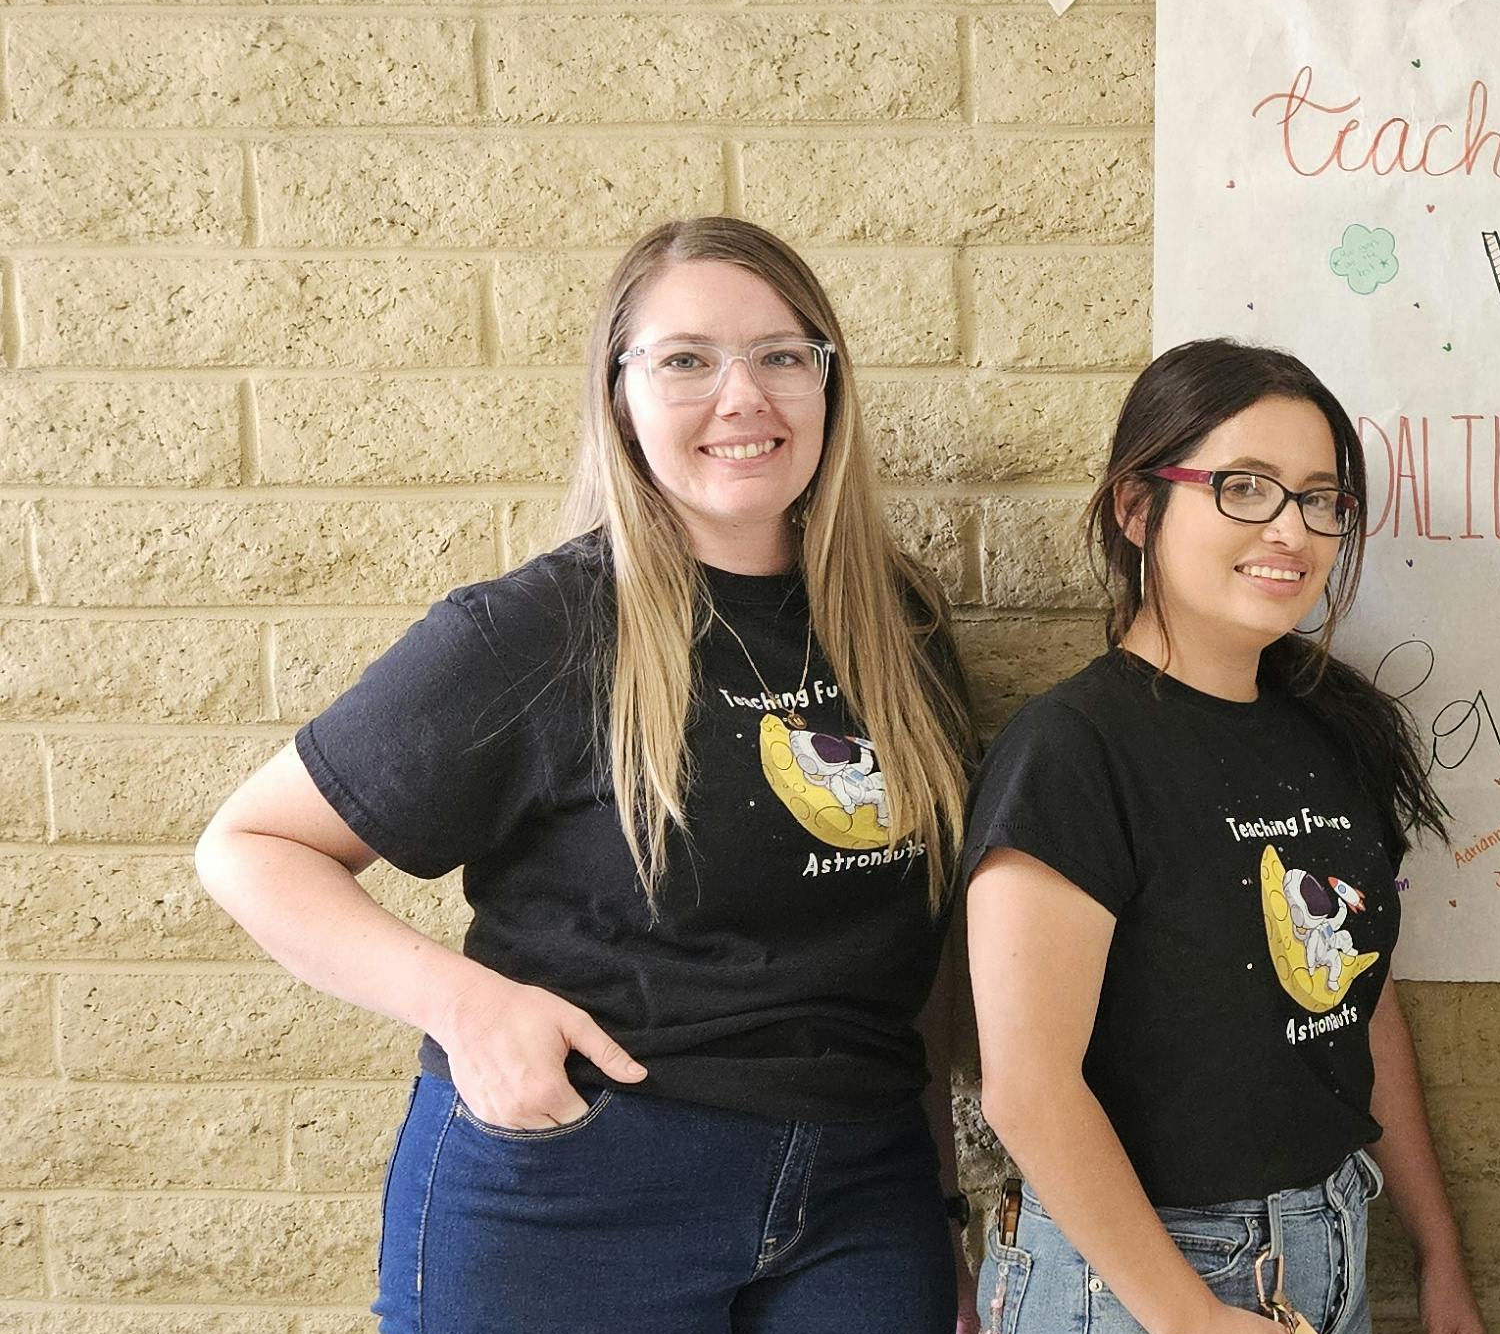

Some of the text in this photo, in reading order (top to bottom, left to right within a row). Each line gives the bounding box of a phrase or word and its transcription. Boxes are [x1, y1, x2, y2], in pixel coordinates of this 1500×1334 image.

[718, 686, 810, 711] Teaching
[1225, 807, 1352, 842] Teaching Fure
[802, 839, 926, 877] Astronauts
[1286, 1002, 1359, 1046] Astronauts
